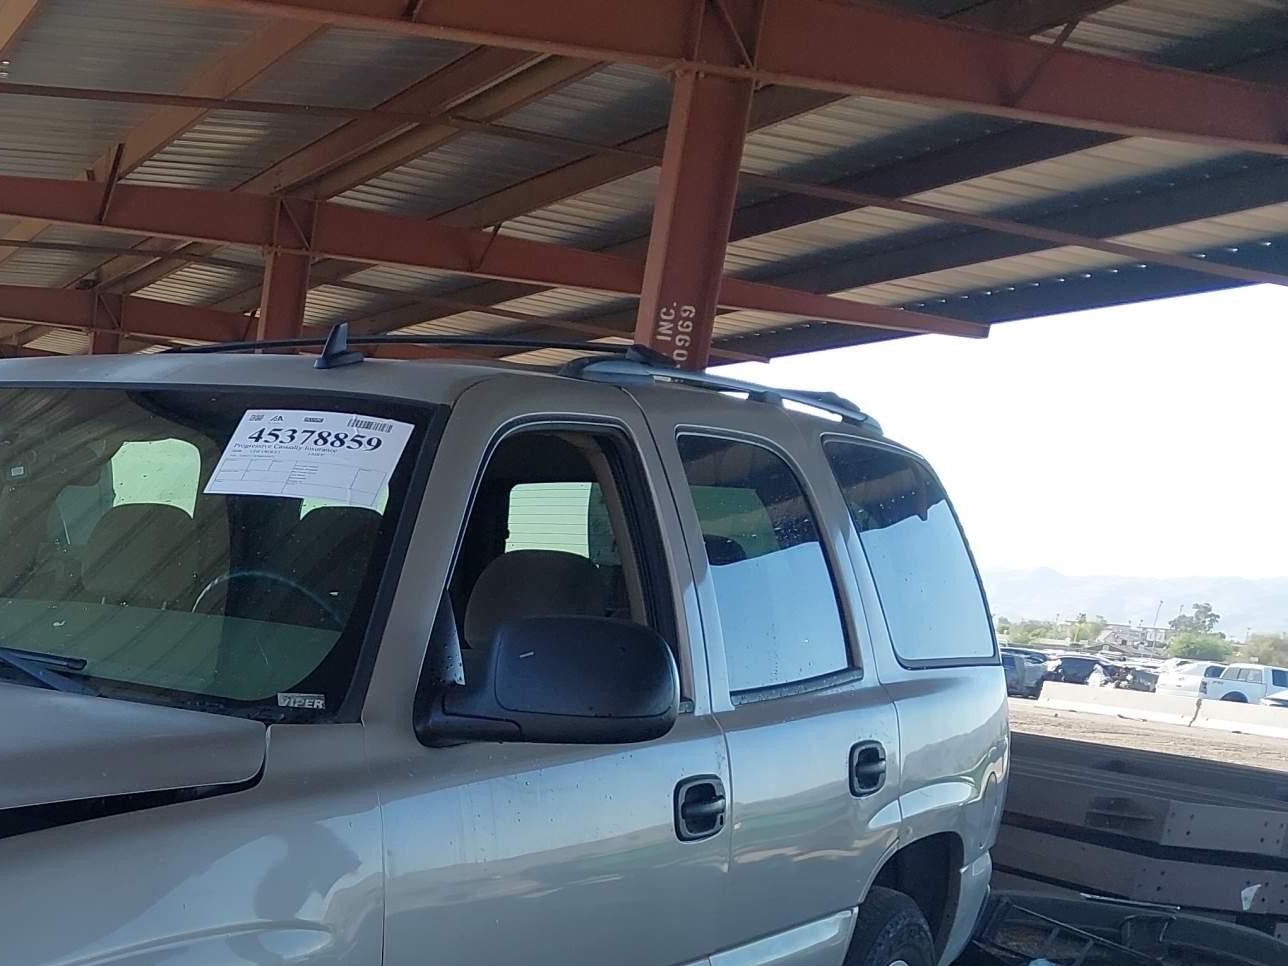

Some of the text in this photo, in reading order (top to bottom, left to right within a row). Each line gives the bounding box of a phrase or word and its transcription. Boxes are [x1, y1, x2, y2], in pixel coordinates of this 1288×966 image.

[655, 302, 677, 341] INC.
[248, 427, 383, 451] 45378859
[279, 696, 325, 709] VIPER
